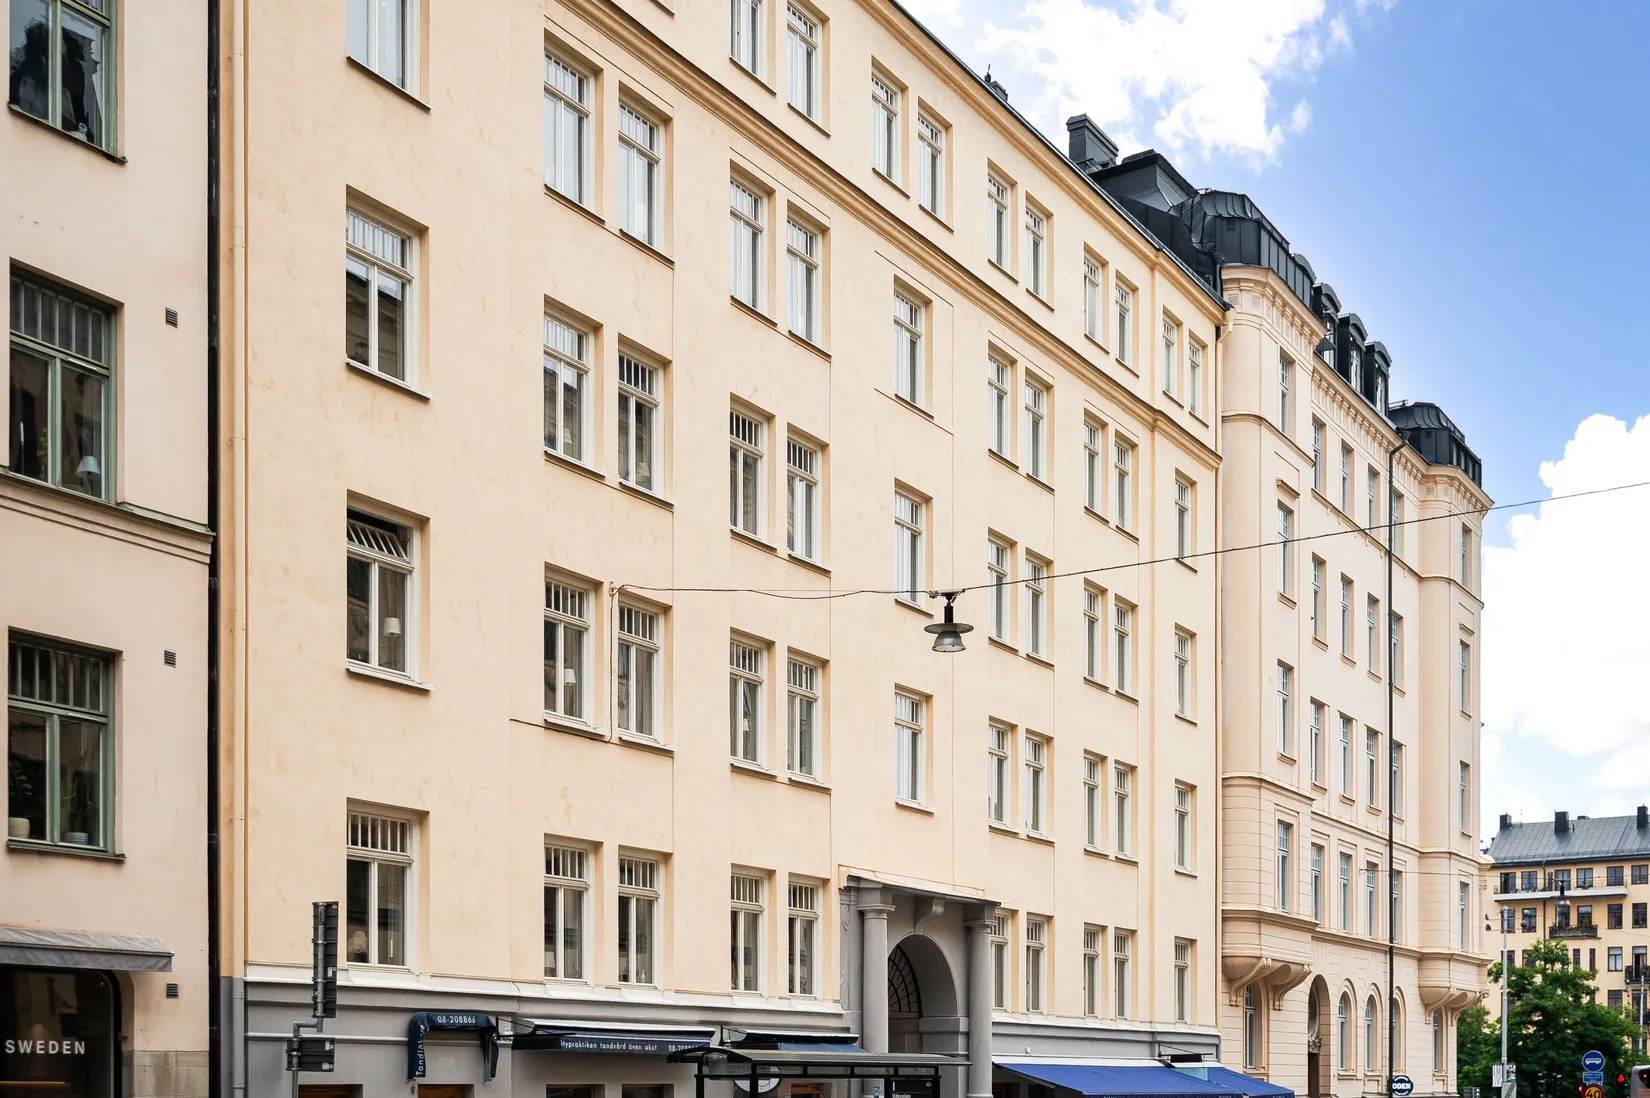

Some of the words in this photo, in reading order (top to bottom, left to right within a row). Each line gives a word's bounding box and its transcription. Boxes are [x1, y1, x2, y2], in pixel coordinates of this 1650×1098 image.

[437, 1015, 476, 1024] 08-208866
[4, 1039, 86, 1055] SWEDEN
[560, 1040, 597, 1049] itypraktiken
[644, 1043, 658, 1051] akut
[1392, 1082, 1411, 1090] ODEN
[1586, 1089, 1601, 1098] 40
